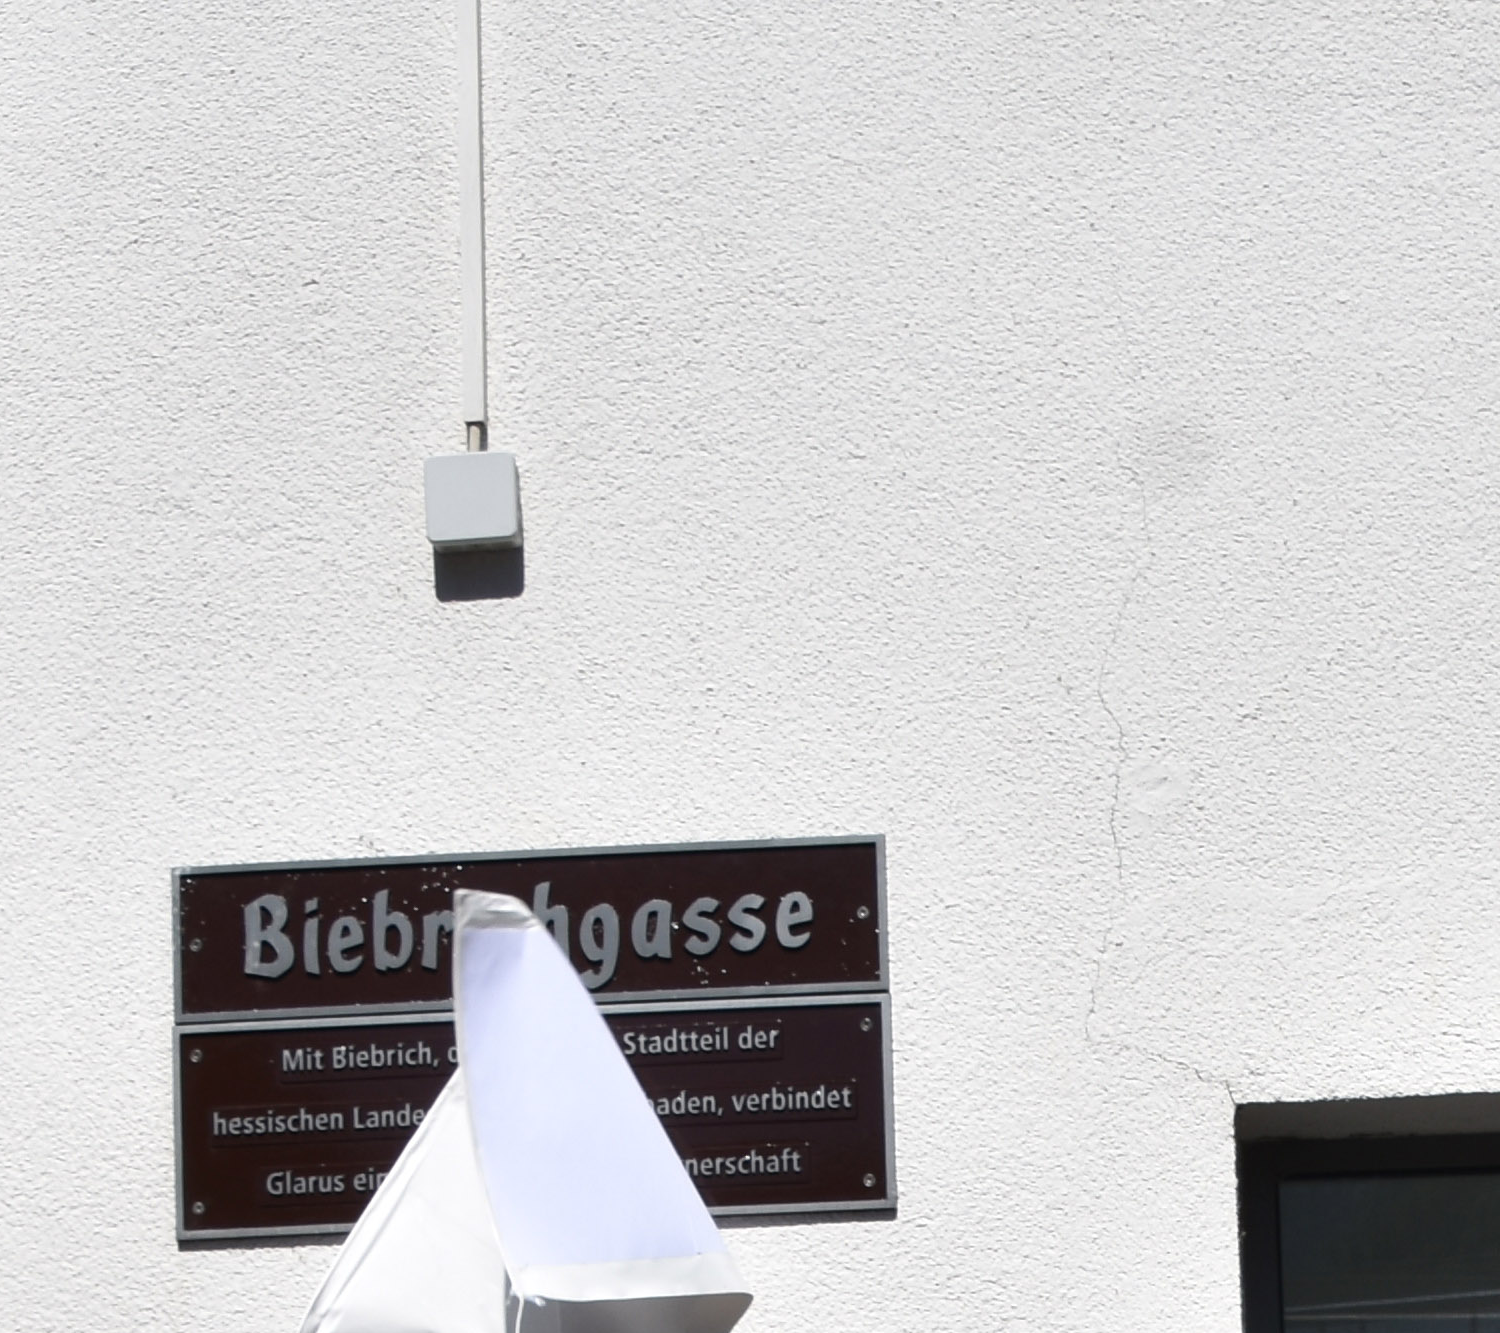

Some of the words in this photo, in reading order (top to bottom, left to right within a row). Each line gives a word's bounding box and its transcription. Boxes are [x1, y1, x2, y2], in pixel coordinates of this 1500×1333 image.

[243, 880, 815, 990] Biebrhgasse
[281, 1048, 325, 1072] Mit
[332, 1041, 440, 1069] Biebrich,
[622, 1026, 729, 1055] Stadtteil
[738, 1025, 779, 1050] der
[212, 1107, 344, 1136] hessischen
[731, 1085, 853, 1111] verbindet
[266, 1170, 345, 1195] Glarus
